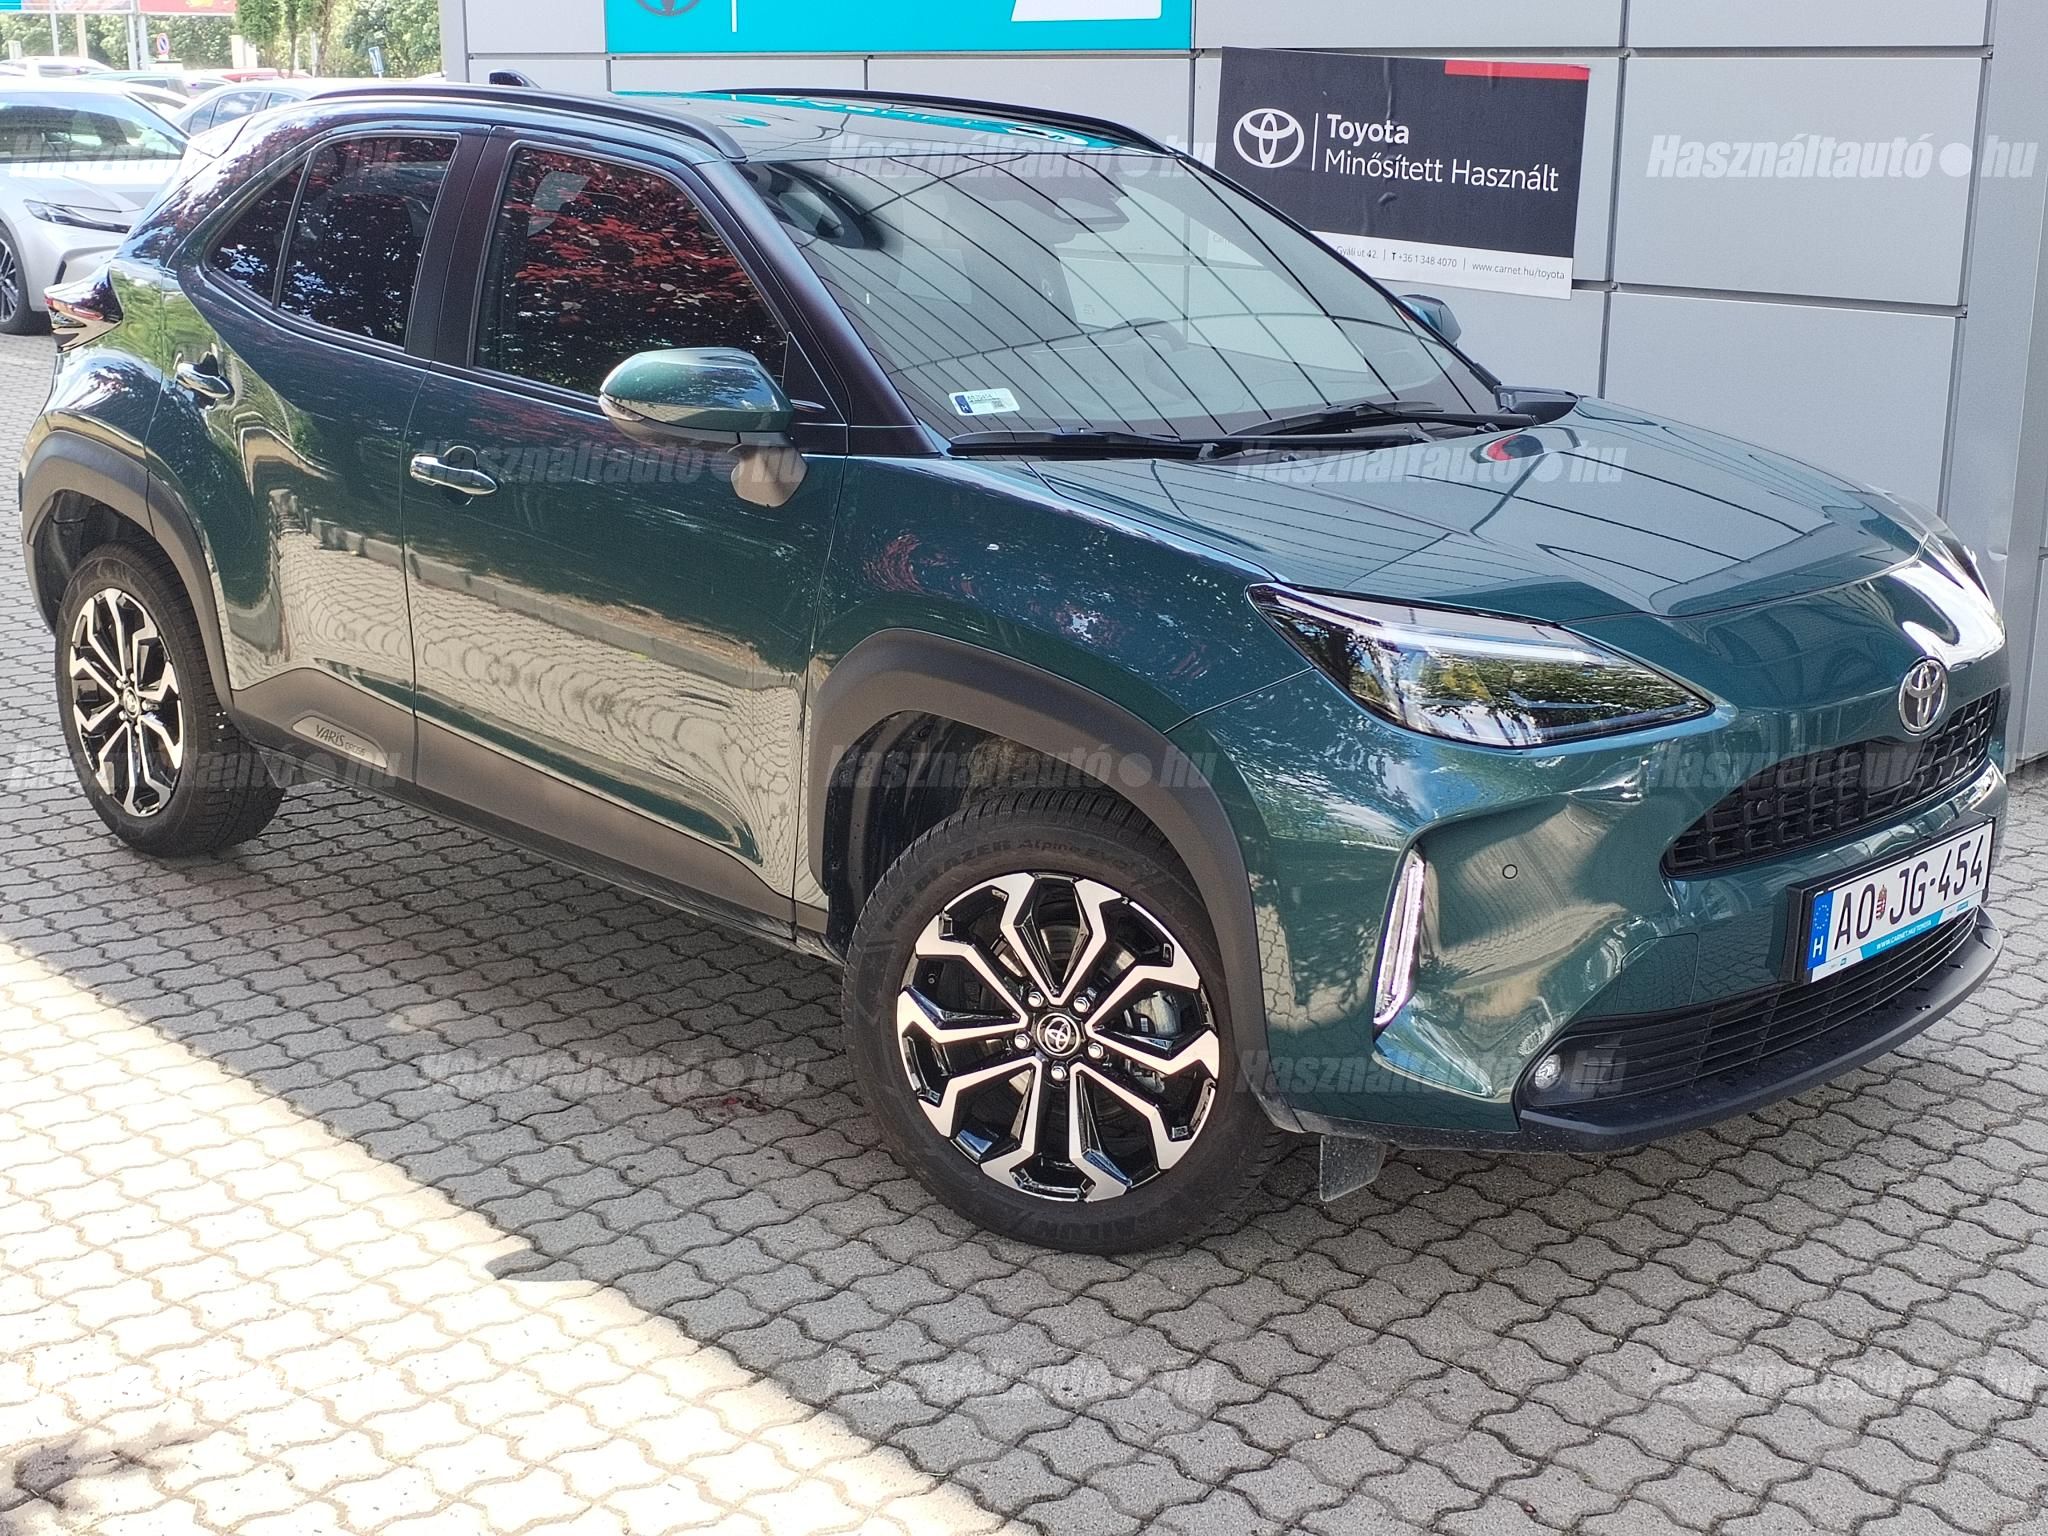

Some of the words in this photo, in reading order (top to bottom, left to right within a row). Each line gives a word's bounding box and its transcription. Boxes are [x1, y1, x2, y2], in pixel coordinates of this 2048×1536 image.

[1326, 113, 1410, 146] Toyota
[1325, 148, 1444, 183] Minősített
[1451, 158, 1559, 192] Használt
[1391, 252, 1397, 261] T
[1398, 253, 1413, 263] +36
[1419, 255, 1436, 265] 348
[1436, 257, 1457, 268] 4070
[1472, 263, 1565, 280] www.carnet.hu/toyota
[316, 724, 345, 747] YARIS
[1833, 883, 1875, 951] AO
[1889, 834, 1985, 925] JG-454
[1812, 935, 1824, 958] H
